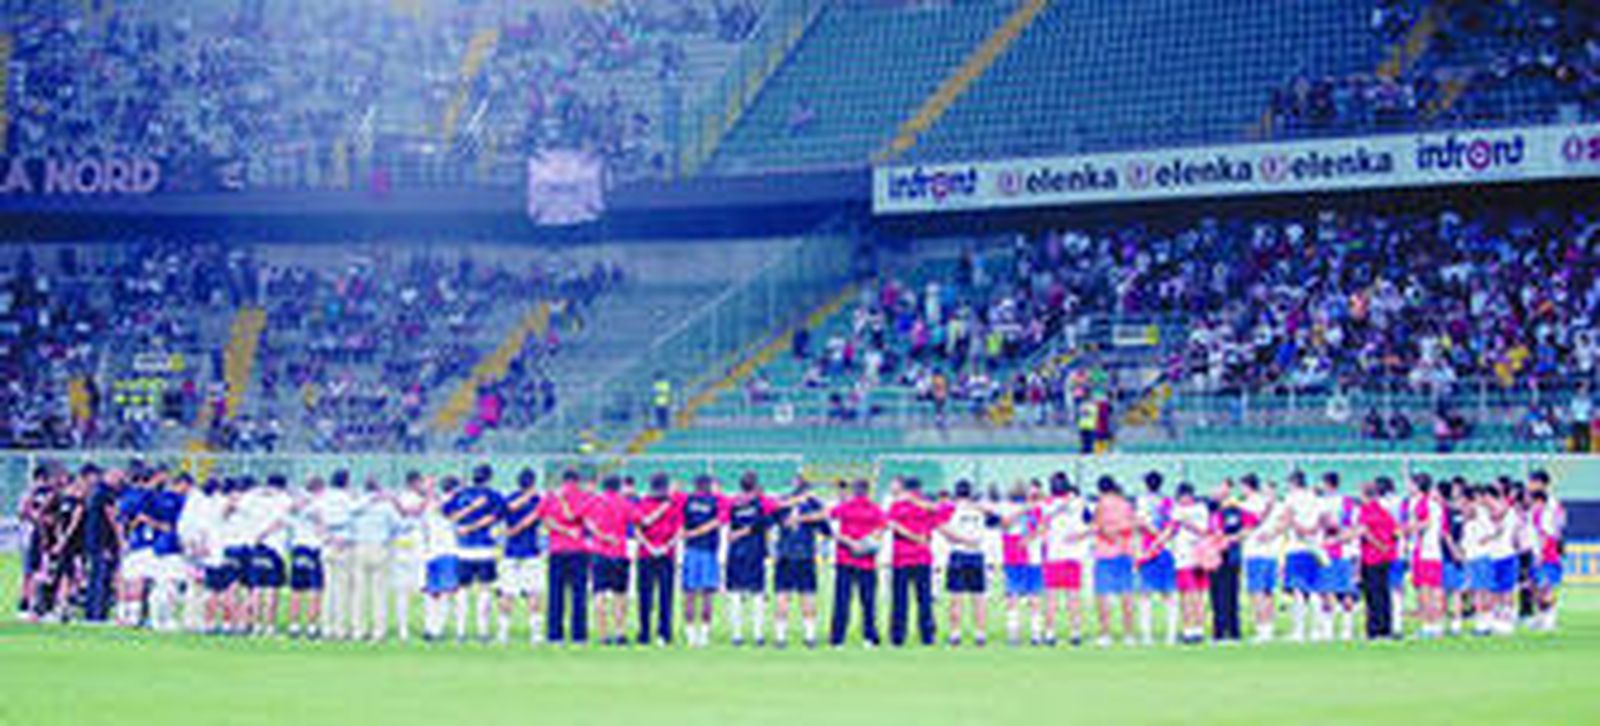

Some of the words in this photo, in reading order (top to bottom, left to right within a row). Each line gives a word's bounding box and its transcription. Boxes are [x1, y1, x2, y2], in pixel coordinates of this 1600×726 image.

[1290, 148, 1393, 179] elenka
[1415, 134, 1525, 171] infront
[45, 157, 160, 193] NORD
[1025, 163, 1119, 193] elenka
[1154, 154, 1252, 187] elenka
